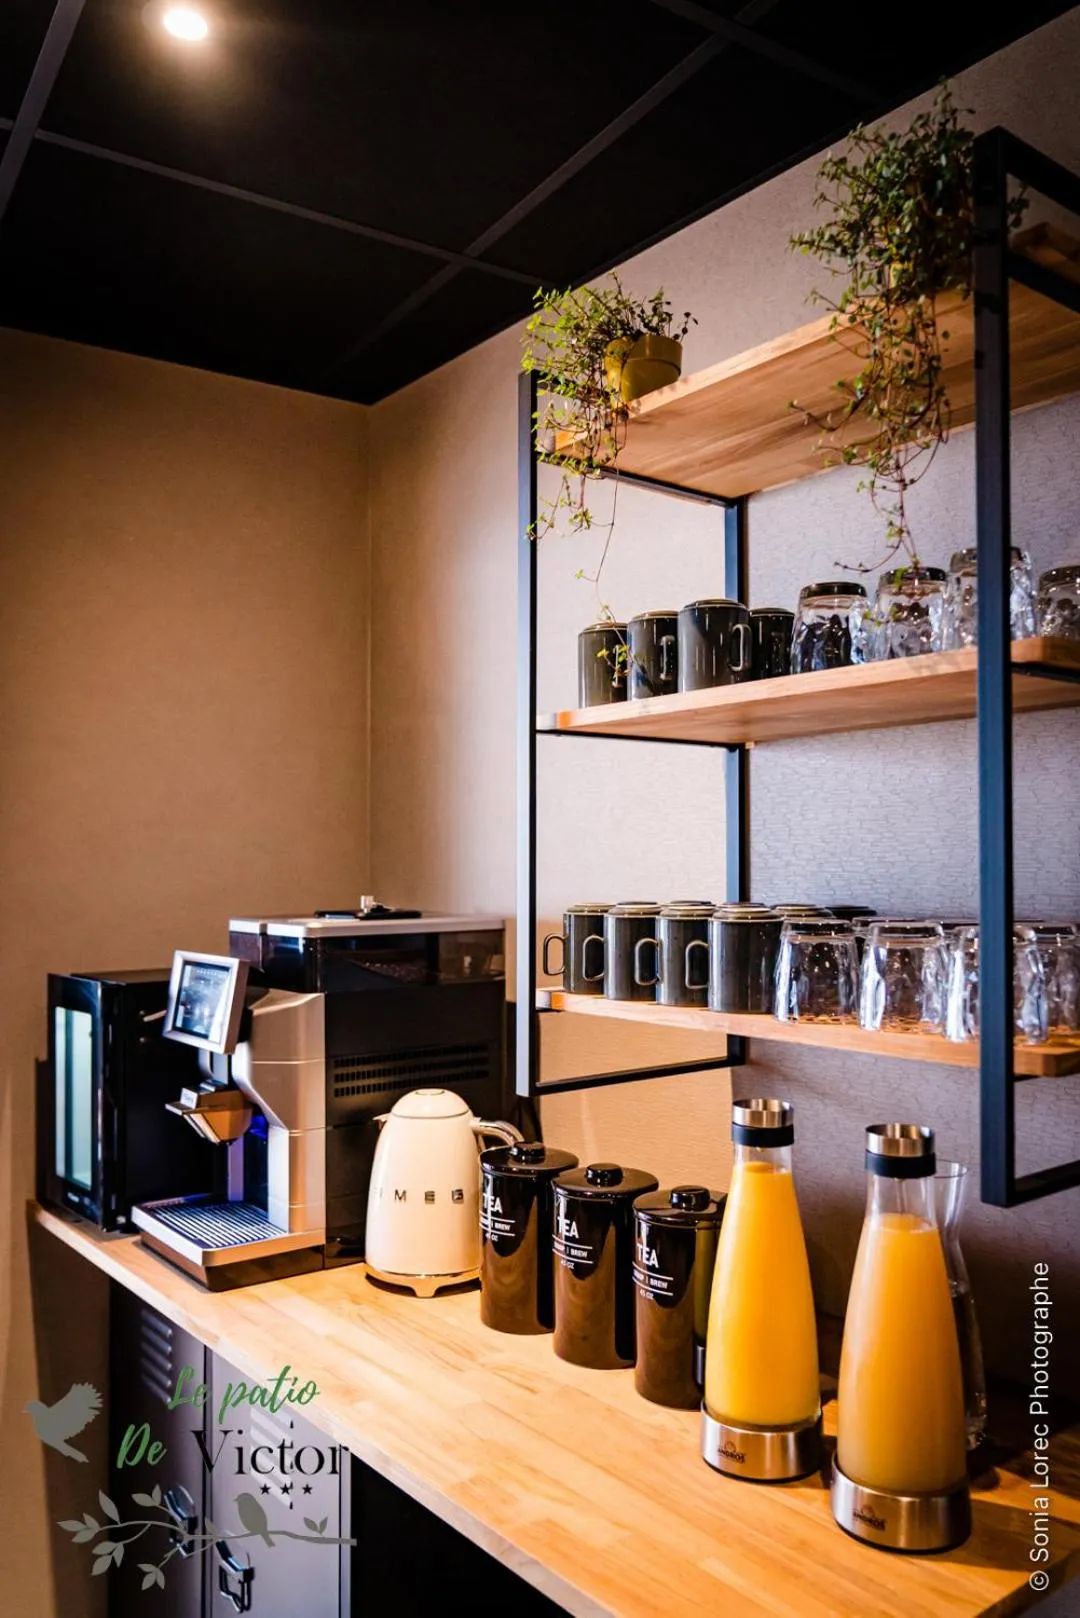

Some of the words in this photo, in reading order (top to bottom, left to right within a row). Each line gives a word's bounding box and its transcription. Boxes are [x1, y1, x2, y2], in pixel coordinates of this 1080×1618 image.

[483, 1192, 503, 1214] TEA
[556, 1215, 579, 1239] TEA
[570, 1248, 588, 1258] BREW
[636, 1243, 659, 1268] TEA
[650, 1278, 668, 1289] BREW
